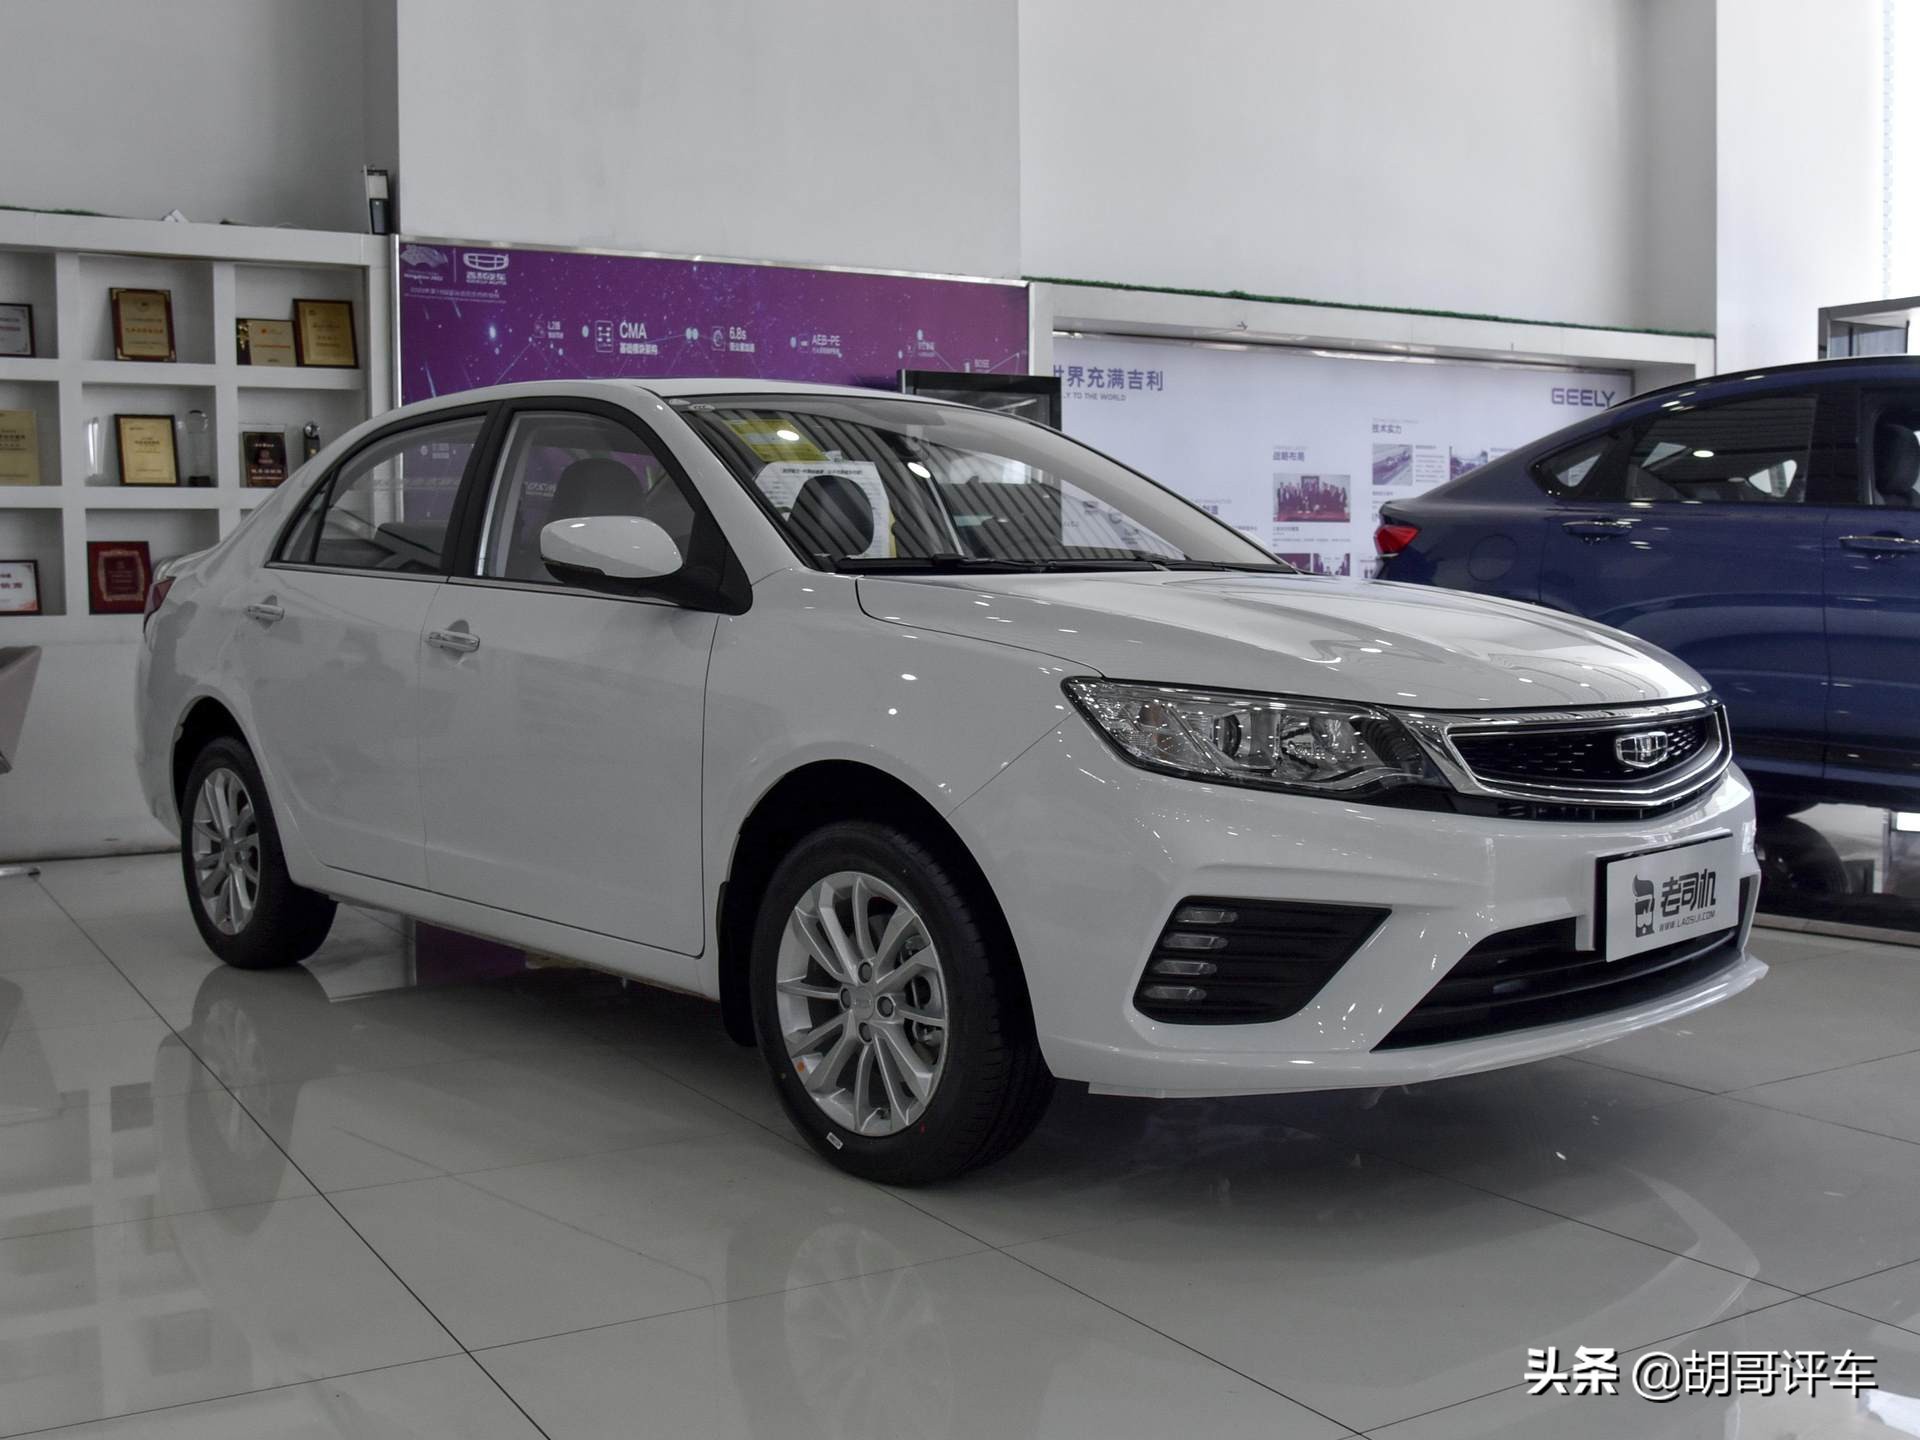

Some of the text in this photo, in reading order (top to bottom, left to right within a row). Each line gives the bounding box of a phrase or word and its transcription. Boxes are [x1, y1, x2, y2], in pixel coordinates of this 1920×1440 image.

[619, 321, 648, 339] CMA
[729, 326, 747, 341] 6.8s
[1073, 391, 1083, 400] TO
[1085, 392, 1098, 400] THE
[1100, 393, 1127, 402] WORLD
[1551, 388, 1616, 409] GEELY
[1660, 868, 1717, 918] 老司机
